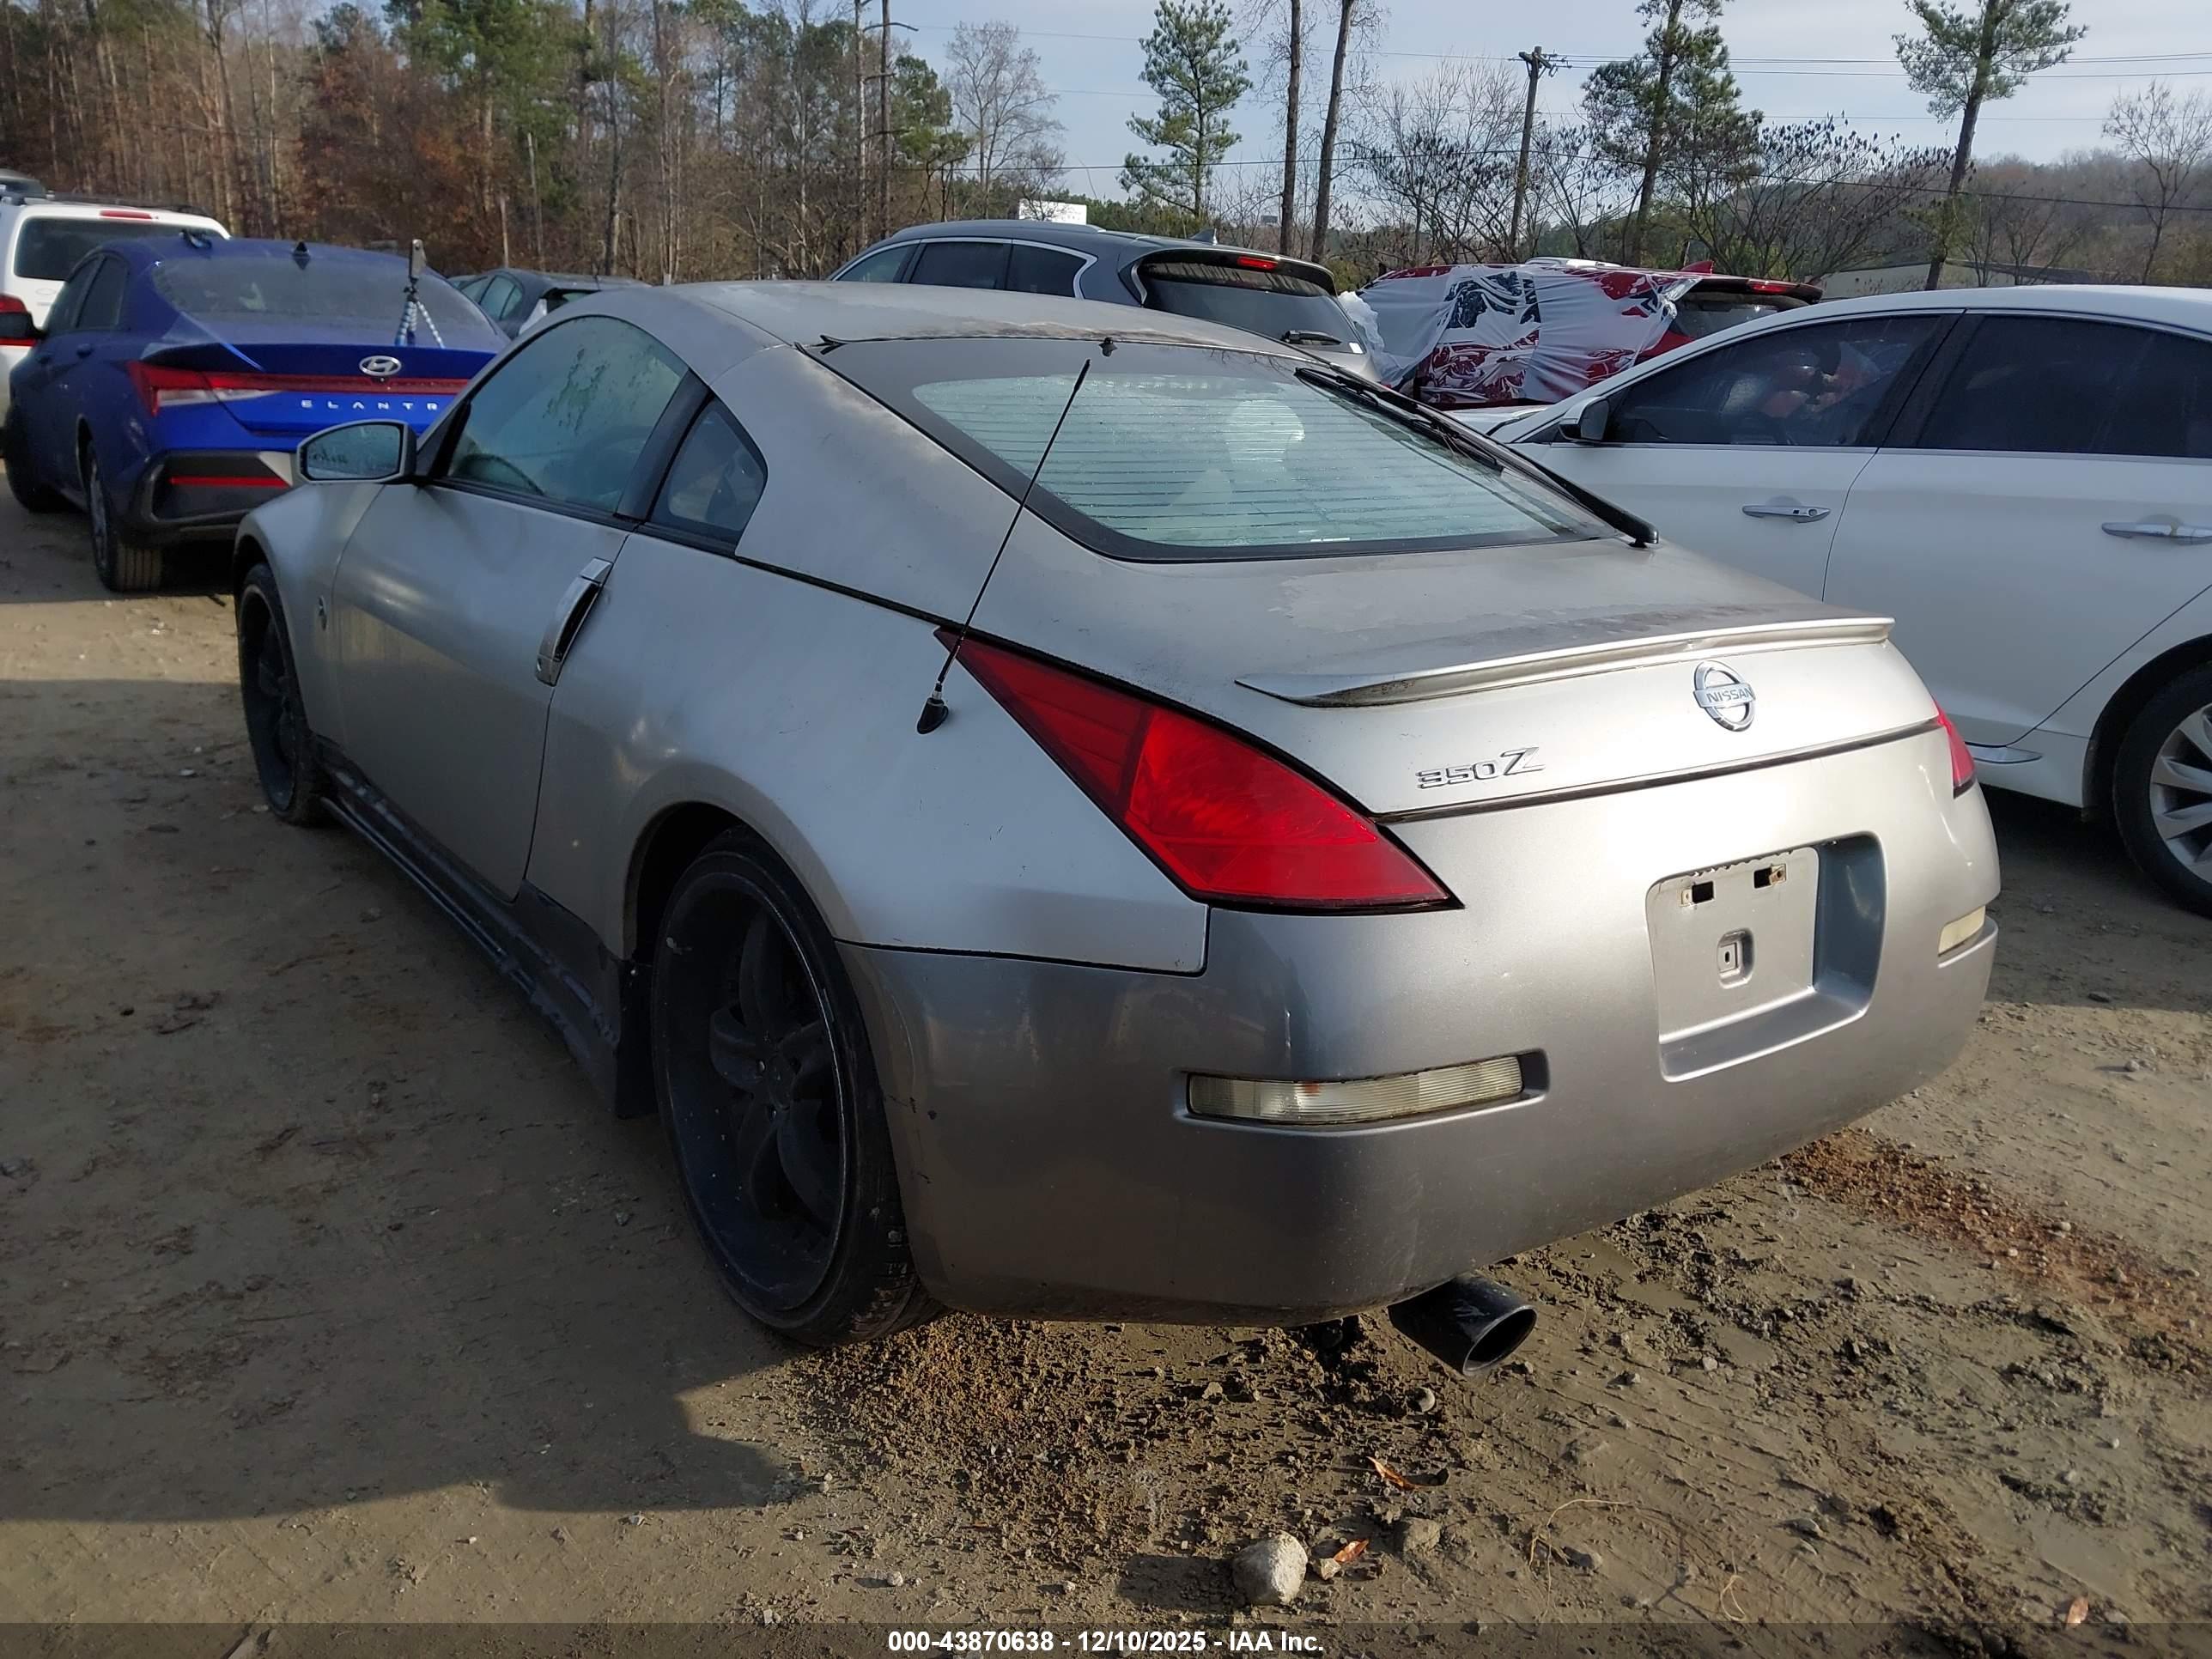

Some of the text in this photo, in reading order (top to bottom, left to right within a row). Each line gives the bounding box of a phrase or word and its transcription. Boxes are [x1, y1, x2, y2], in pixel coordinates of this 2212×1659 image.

[301, 399, 438, 410] ELANTR
[1705, 688, 1754, 703] NISSAN
[1415, 746, 1547, 789] 350Z
